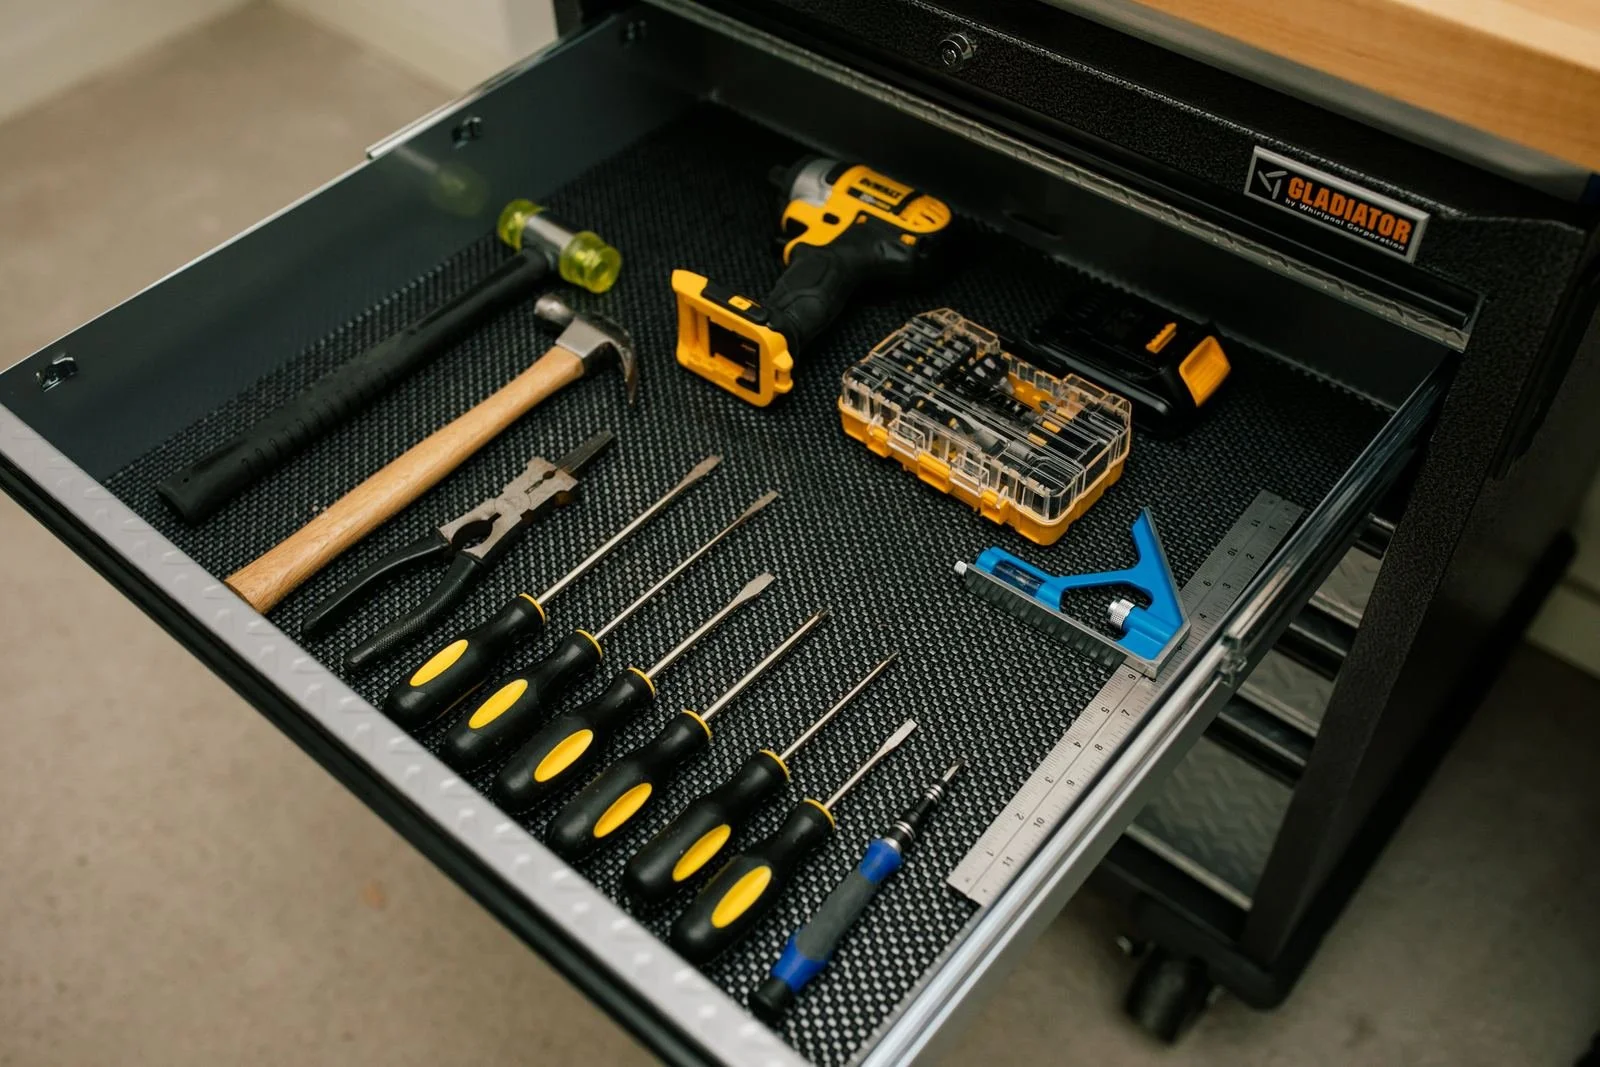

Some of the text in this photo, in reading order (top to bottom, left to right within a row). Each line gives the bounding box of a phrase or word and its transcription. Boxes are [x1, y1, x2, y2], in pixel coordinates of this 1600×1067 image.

[1284, 197, 1405, 251] by Whirlpool Corporation
[1287, 176, 1412, 244] GLADIATOR
[1100, 706, 1110, 714] 5
[1044, 776, 1054, 784] 3
[1002, 856, 1014, 867] 11
[1033, 817, 1045, 828] 10
[1094, 743, 1104, 751] 8
[1016, 812, 1025, 821] 2
